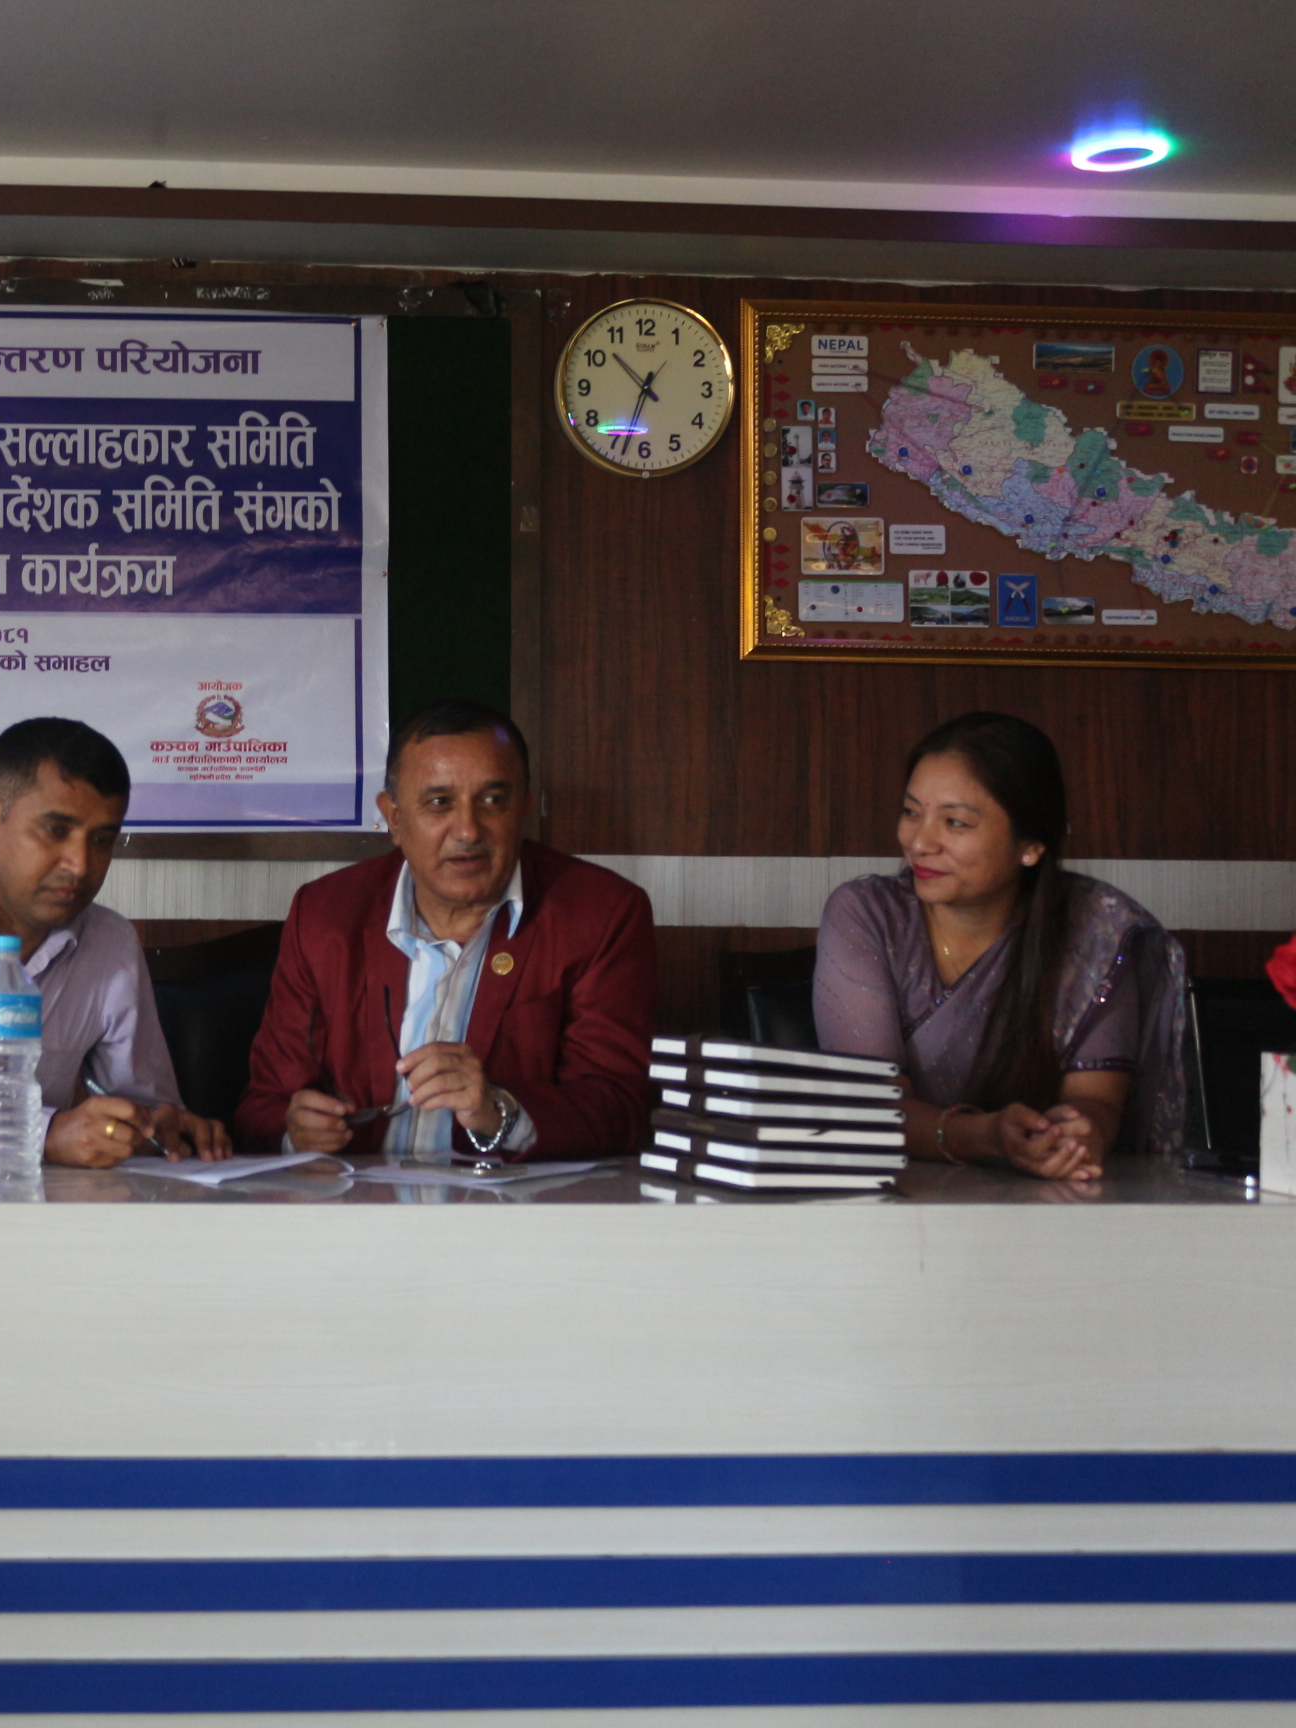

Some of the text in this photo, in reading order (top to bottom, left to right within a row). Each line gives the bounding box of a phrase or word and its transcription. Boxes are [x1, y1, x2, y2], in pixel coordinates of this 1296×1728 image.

[607, 326, 623, 344] 11
[636, 319, 656, 336] 12
[672, 328, 679, 345] 1
[818, 339, 864, 351] NEPAL
[97, 339, 261, 374] परियोजना
[584, 349, 606, 367] 10
[693, 350, 705, 367] 2
[578, 379, 591, 396] 9
[701, 381, 713, 398] 3
[585, 410, 599, 427] 8
[692, 413, 703, 429] 4
[208, 411, 316, 468] समिति
[608, 433, 621, 450] 7
[669, 435, 681, 451] 5
[638, 442, 651, 459] 6
[113, 474, 221, 533] समिति
[234, 478, 341, 534] संगको
[22, 543, 176, 597] कार्यक्रम
[34, 654, 111, 672] सभाहल
[198, 680, 243, 691] आयोजक
[150, 738, 288, 752] कञ्चन गाउँपालिका
